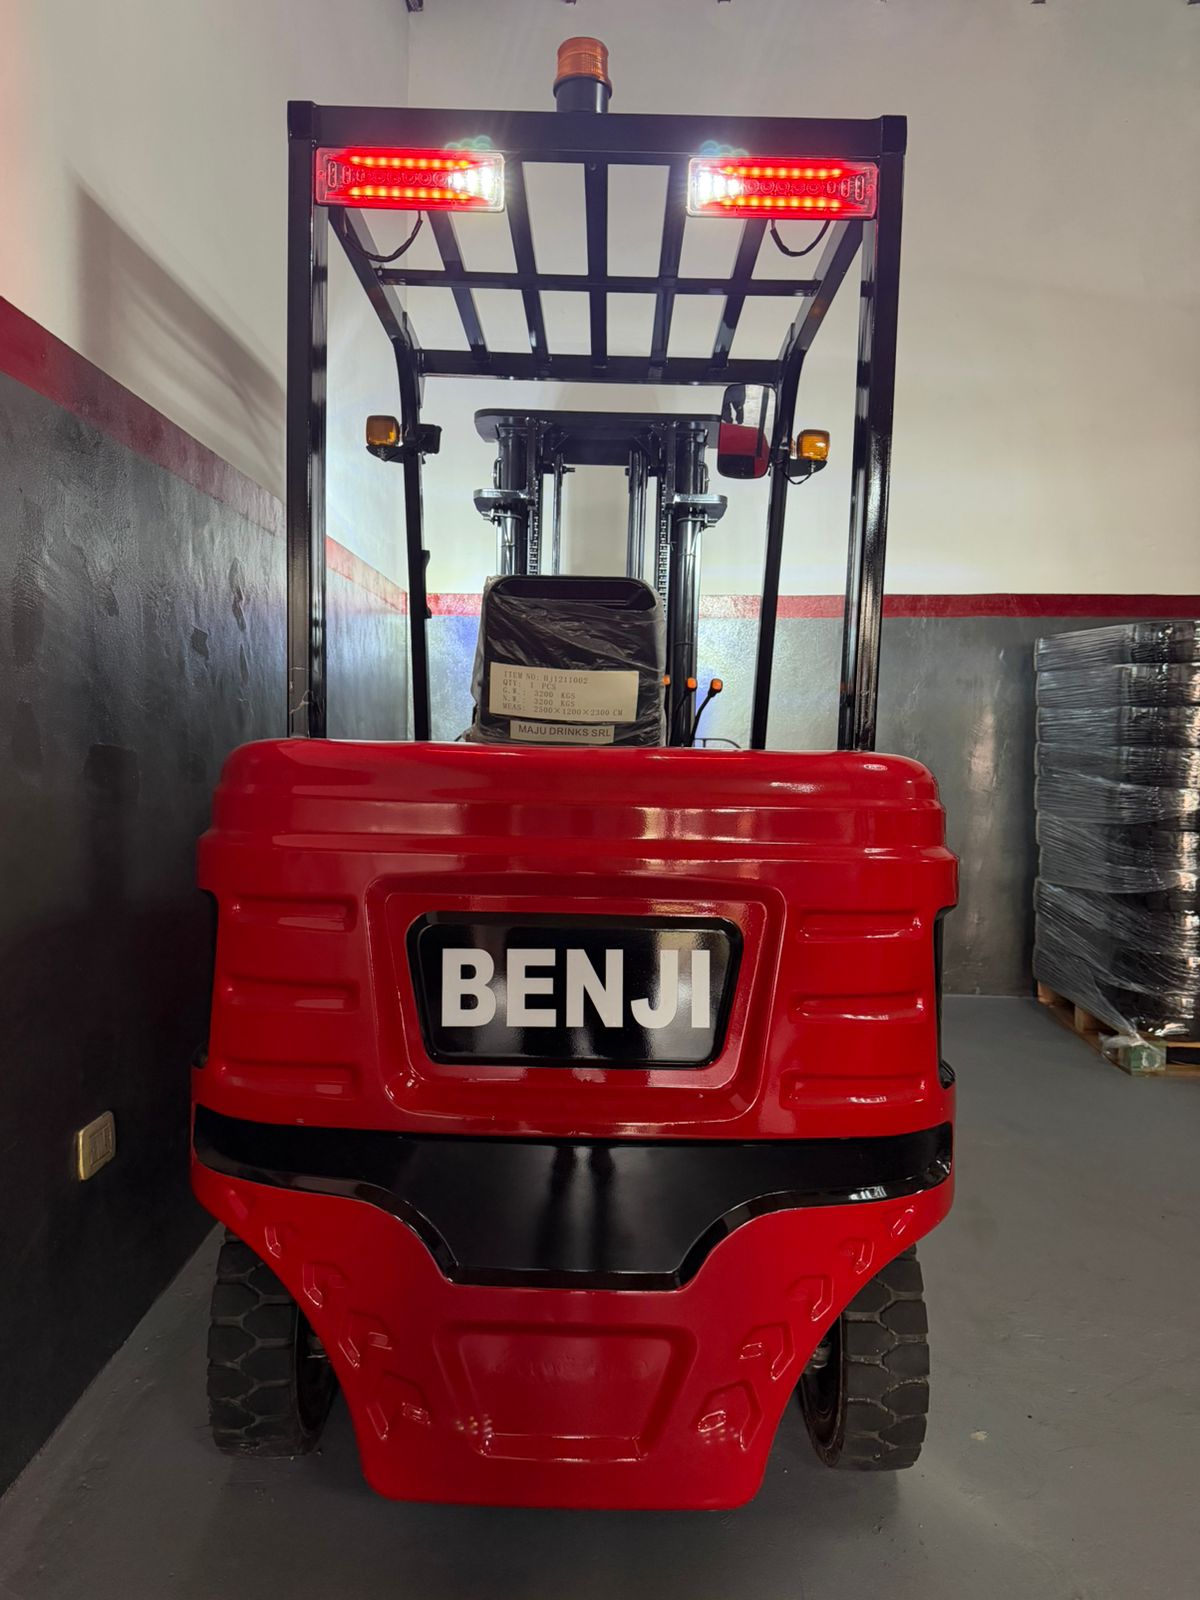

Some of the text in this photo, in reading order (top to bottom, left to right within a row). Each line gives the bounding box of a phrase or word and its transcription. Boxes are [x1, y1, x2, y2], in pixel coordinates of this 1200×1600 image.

[534, 690, 554, 698] 3200
[518, 724, 611, 737] MAJU DRINKS SRL
[441, 948, 711, 1029] BENJI
